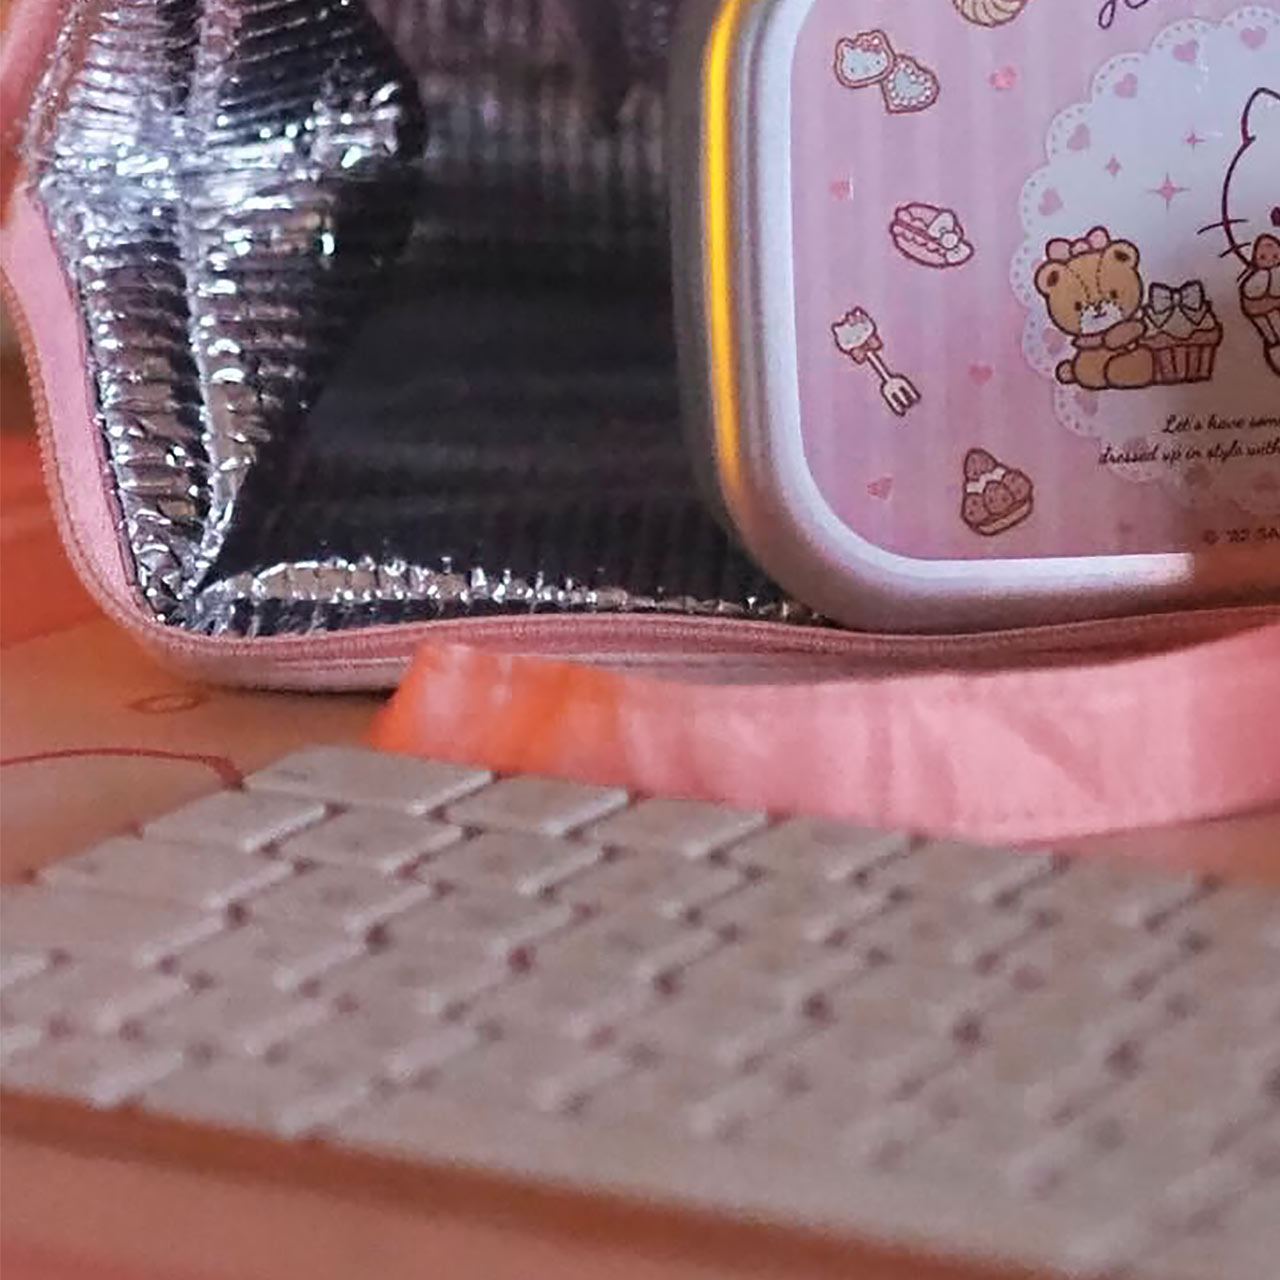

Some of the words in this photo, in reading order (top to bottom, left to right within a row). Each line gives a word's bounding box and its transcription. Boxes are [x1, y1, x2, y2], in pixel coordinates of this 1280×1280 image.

[1162, 414, 1202, 433] Let's
[1207, 413, 1245, 430] have
[1098, 444, 1158, 465] dressed
[1162, 446, 1182, 465] up
[1185, 446, 1202, 461] in
[1206, 439, 1242, 463] style
